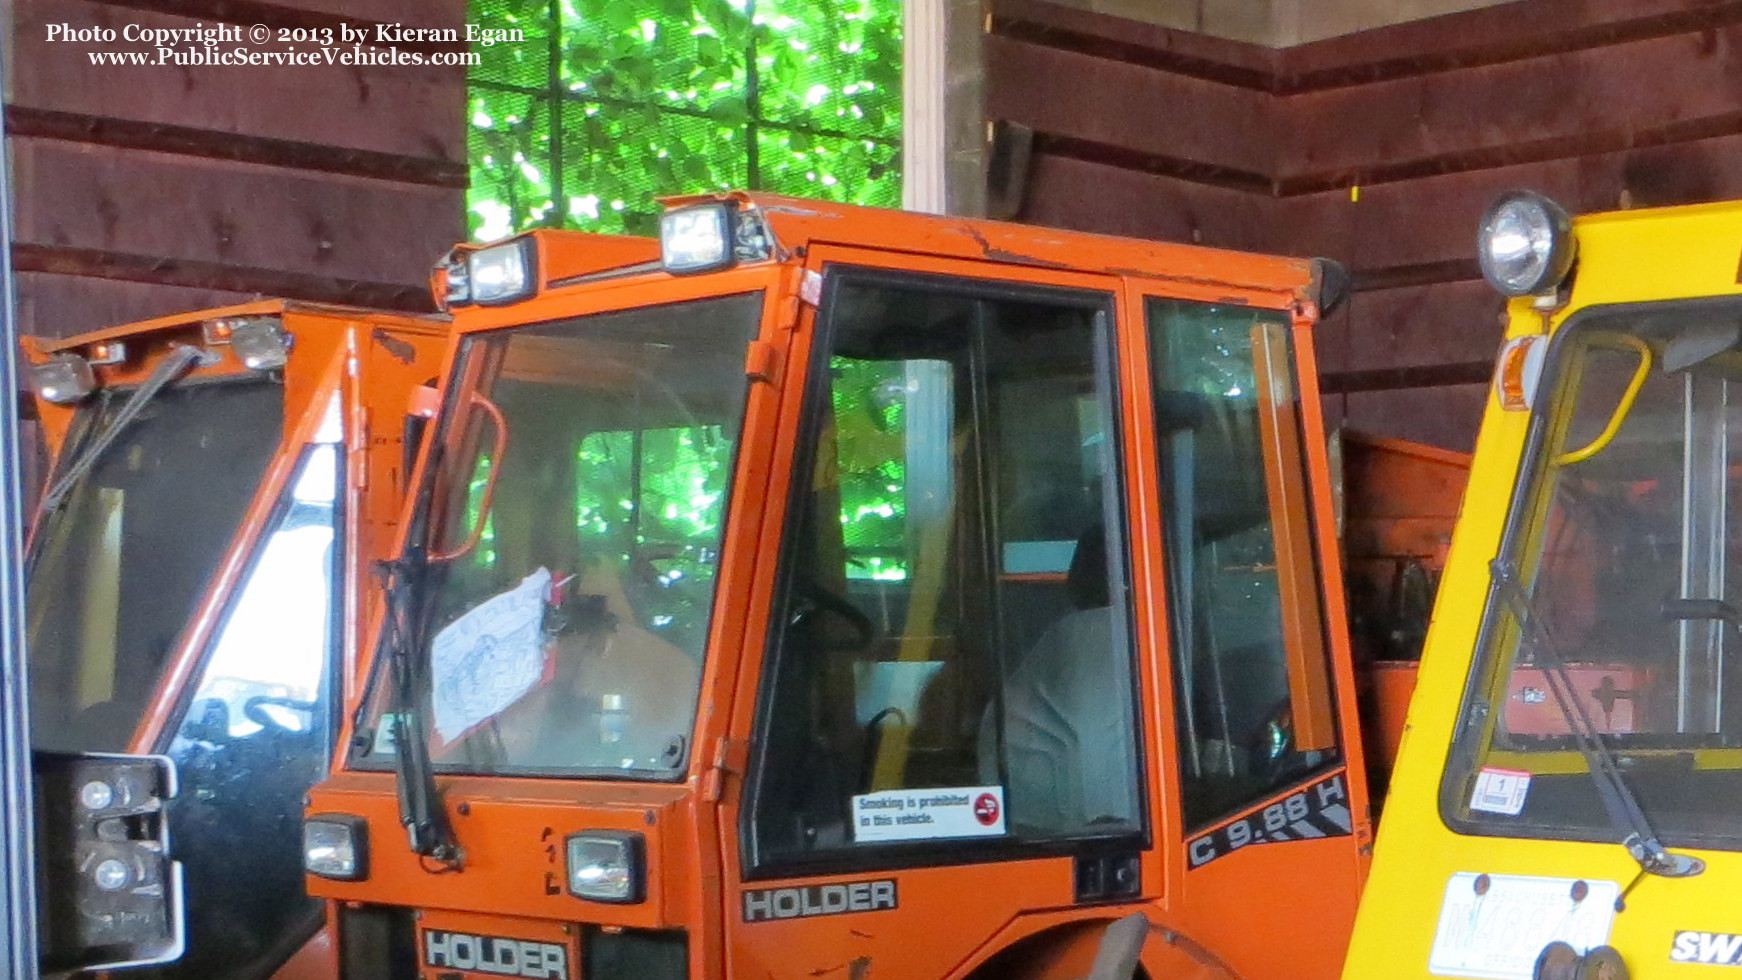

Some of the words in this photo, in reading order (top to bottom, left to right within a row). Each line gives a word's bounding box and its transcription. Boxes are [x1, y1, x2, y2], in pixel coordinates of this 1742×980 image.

[859, 797, 904, 811] Smoking
[919, 794, 970, 809] prohibited
[1189, 836, 1216, 866] C
[1227, 793, 1310, 849] 9.88
[1316, 776, 1345, 807] H
[745, 880, 896, 922] HOLDER
[426, 930, 567, 980] HOLDER
